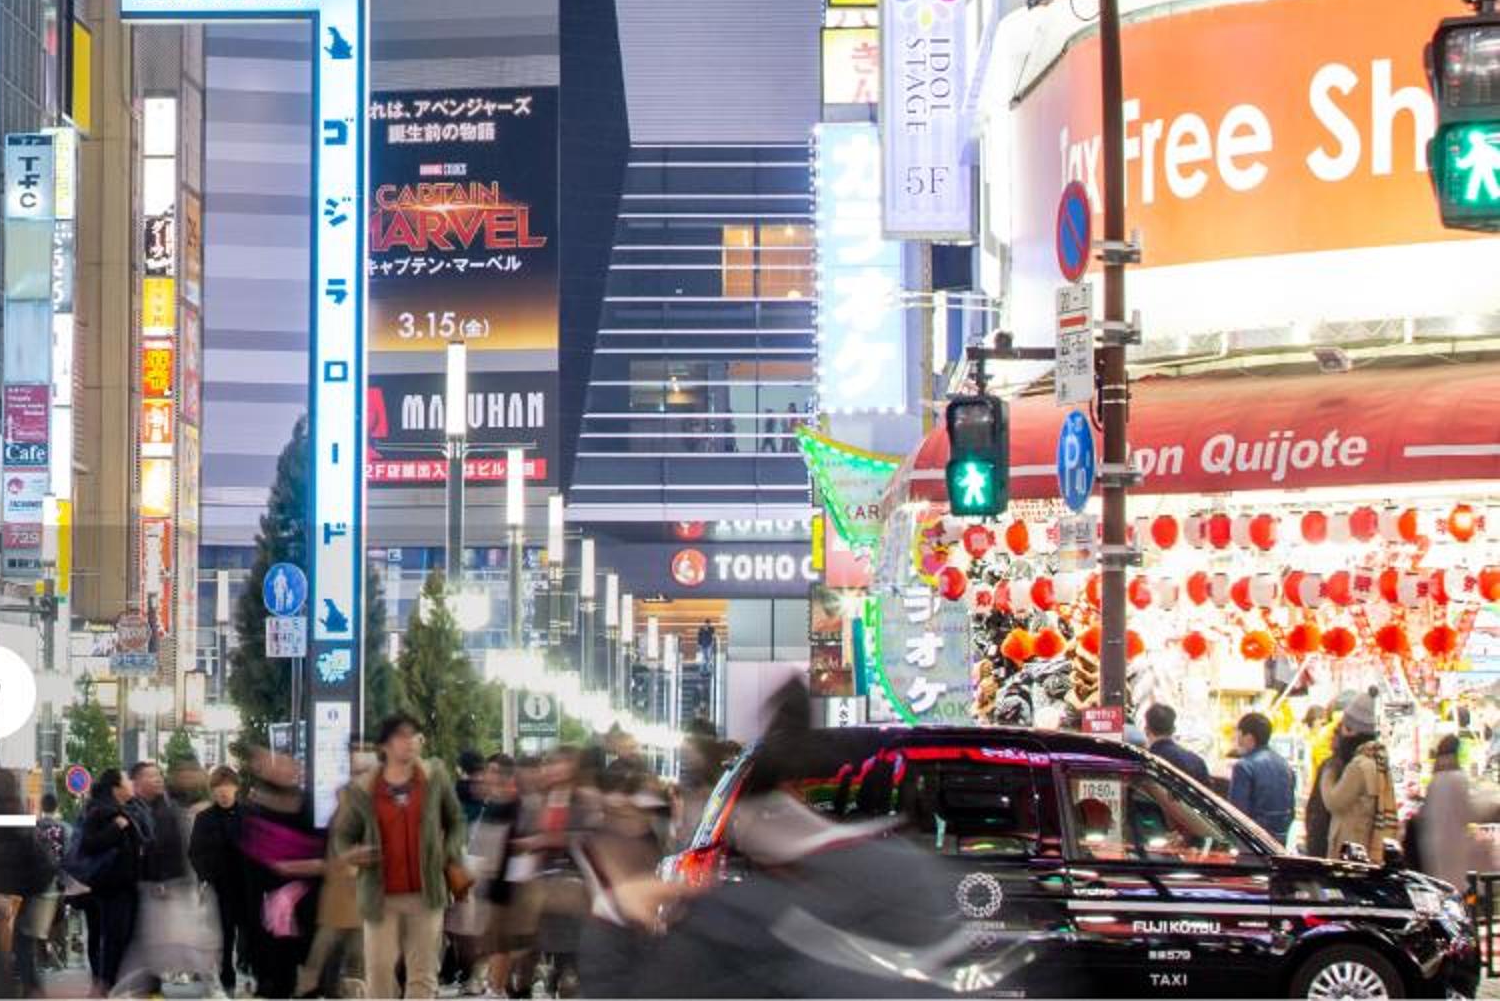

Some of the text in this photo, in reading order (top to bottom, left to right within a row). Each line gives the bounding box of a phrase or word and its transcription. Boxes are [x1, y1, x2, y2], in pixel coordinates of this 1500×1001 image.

[905, 36, 927, 135] STAGE
[929, 36, 951, 116] IDOL
[387, 122, 496, 144] 誕生前の物語
[1122, 98, 1273, 207] Free
[375, 181, 500, 206] CAPTAIN
[905, 165, 949, 196] 5F
[322, 117, 355, 546] ゴジラロード
[401, 392, 544, 431] MAUHAN
[5, 444, 46, 461] Cafe
[1126, 428, 1369, 482] on Quijote
[714, 555, 800, 580] TOHO
[1149, 972, 1188, 987] TAXI
